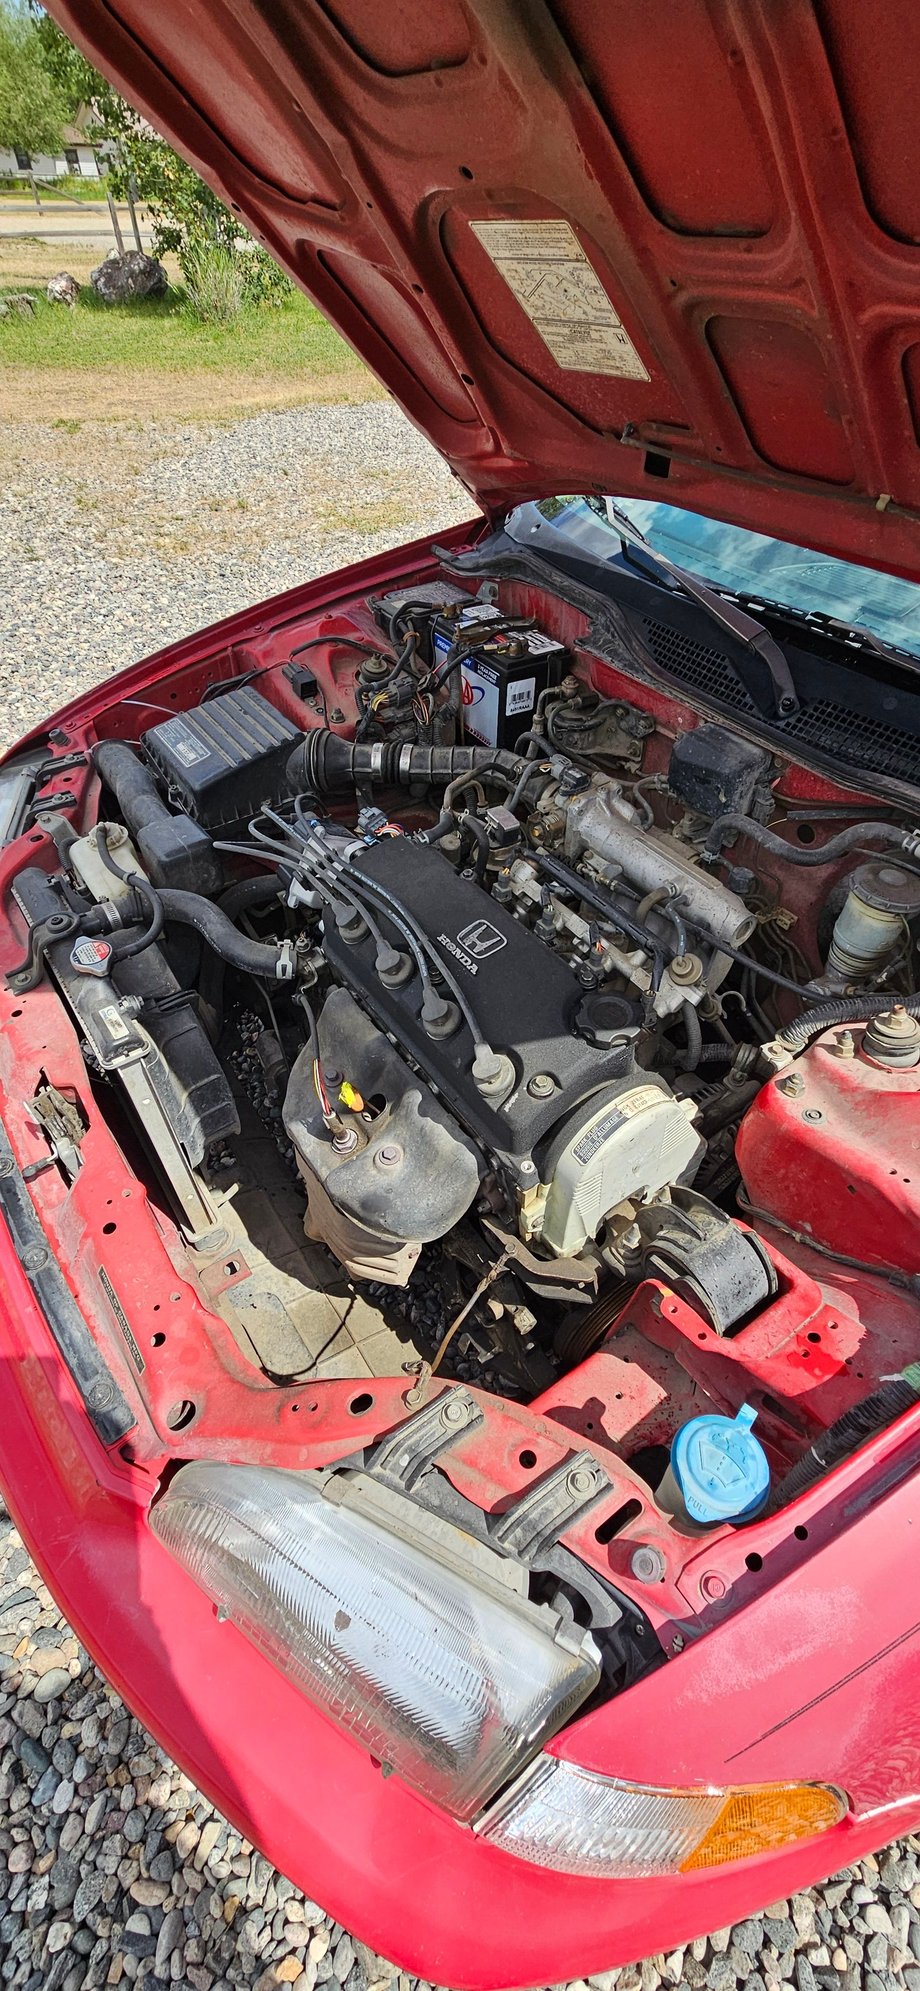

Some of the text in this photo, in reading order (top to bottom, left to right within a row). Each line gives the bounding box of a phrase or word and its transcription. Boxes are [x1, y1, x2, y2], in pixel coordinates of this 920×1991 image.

[437, 934, 479, 975] HONDA
[575, 1125, 599, 1153] SPARK PLUG
[101, 1271, 114, 1297] HONDA
[117, 1309, 133, 1342] CANADA
[688, 1496, 708, 1516] PULL
